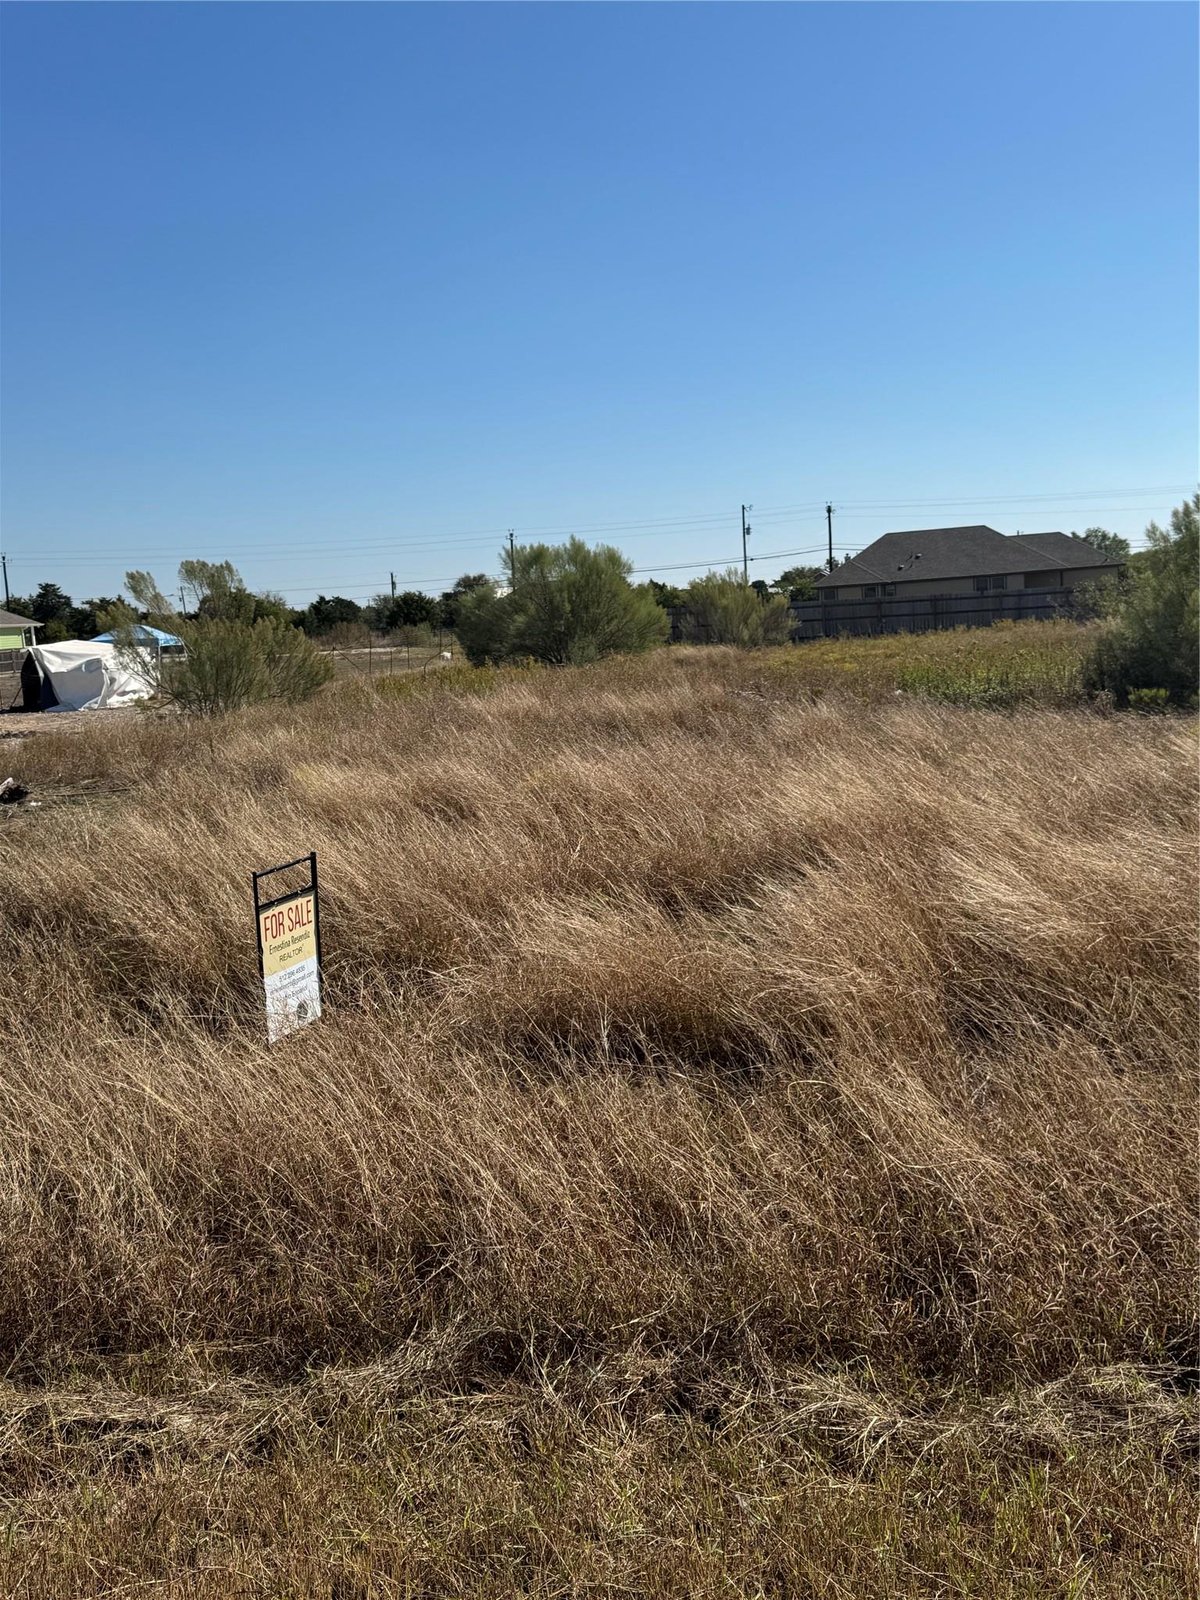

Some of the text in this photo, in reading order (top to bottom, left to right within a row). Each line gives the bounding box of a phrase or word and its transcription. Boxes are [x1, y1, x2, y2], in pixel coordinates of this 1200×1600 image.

[263, 899, 313, 942] FOR SALE
[269, 939, 291, 955] Ernestina
